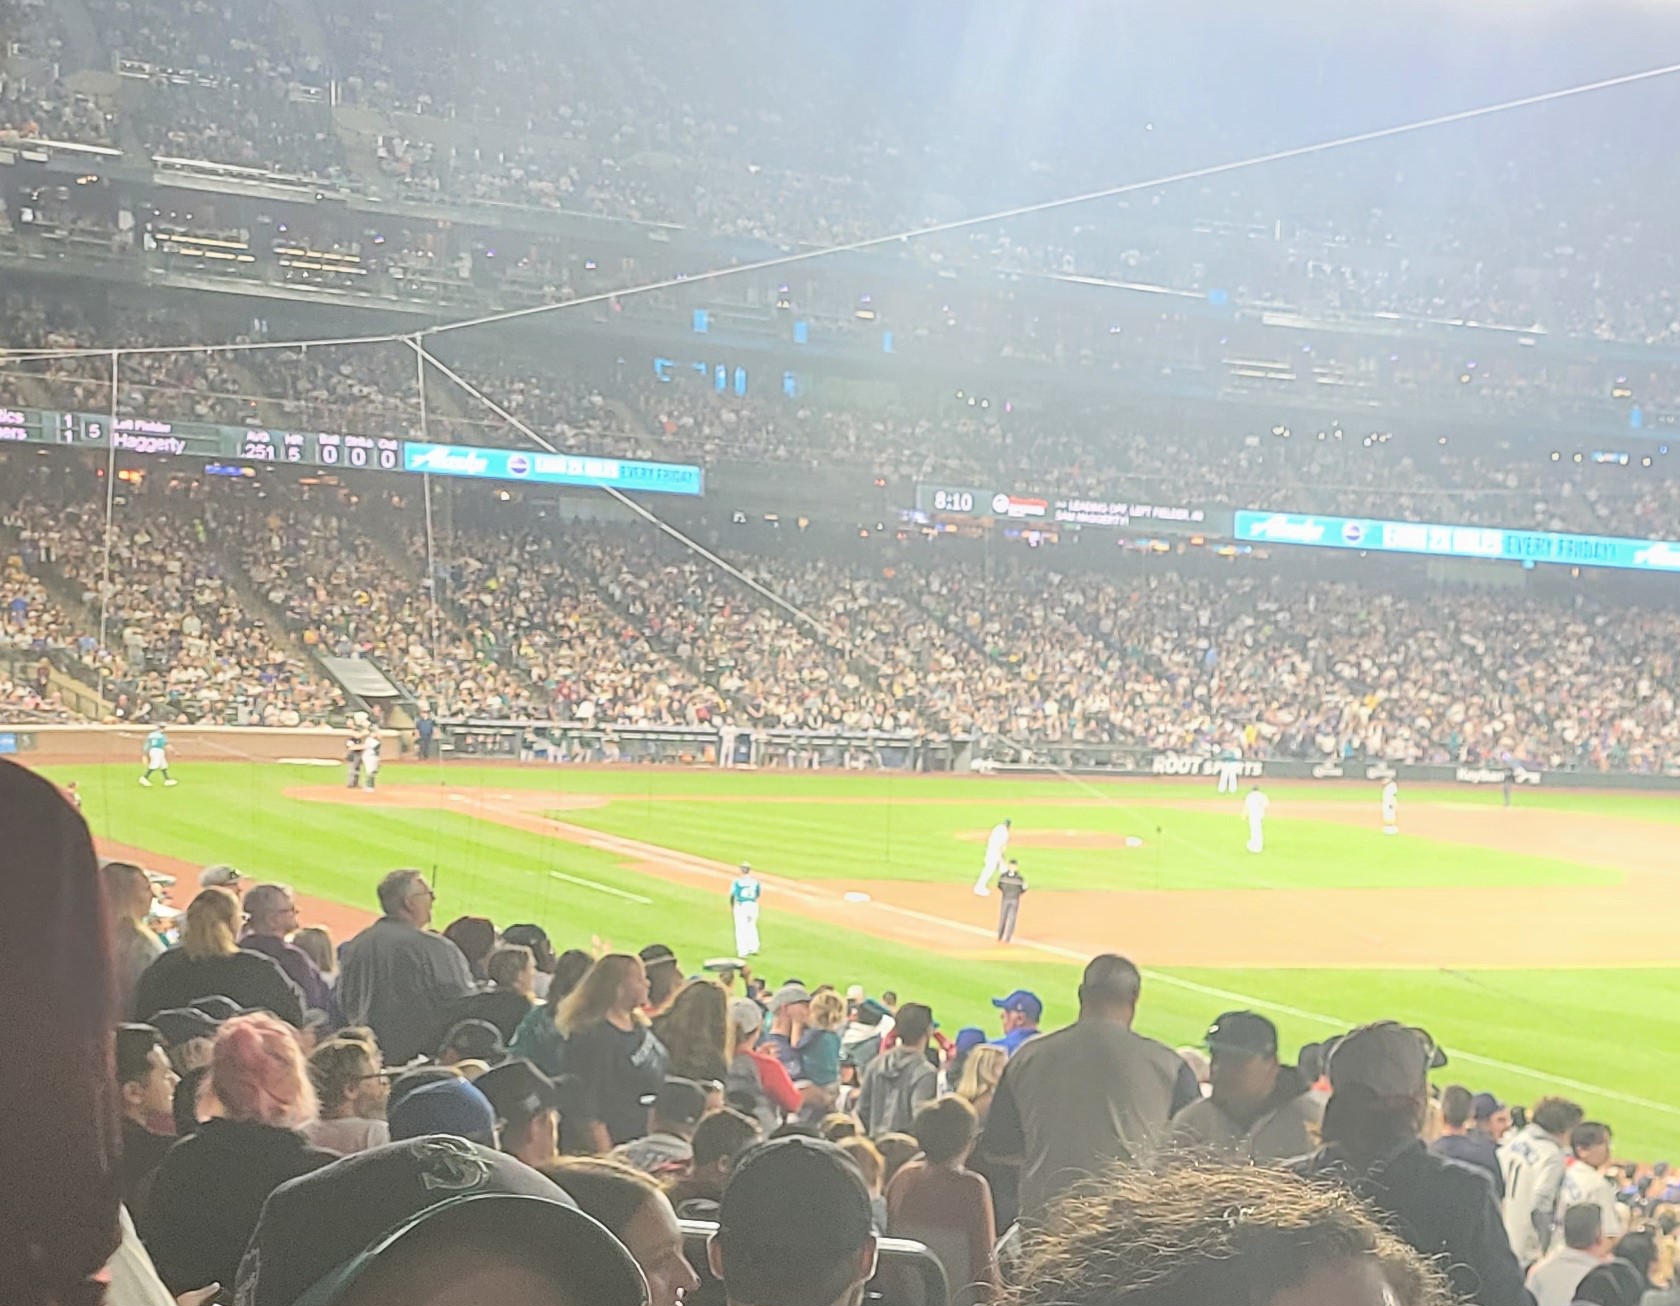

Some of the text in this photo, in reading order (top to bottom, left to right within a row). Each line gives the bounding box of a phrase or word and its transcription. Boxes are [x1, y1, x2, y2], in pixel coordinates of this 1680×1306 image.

[88, 424, 101, 438] 5
[114, 432, 186, 455] Haggerty
[322, 445, 338, 464] 0
[351, 447, 367, 466] 0
[380, 450, 396, 469] 0
[935, 491, 973, 512] 8:10
[1152, 754, 1263, 777] ROOT SPRTS
[1456, 767, 1507, 783] KeyBan
